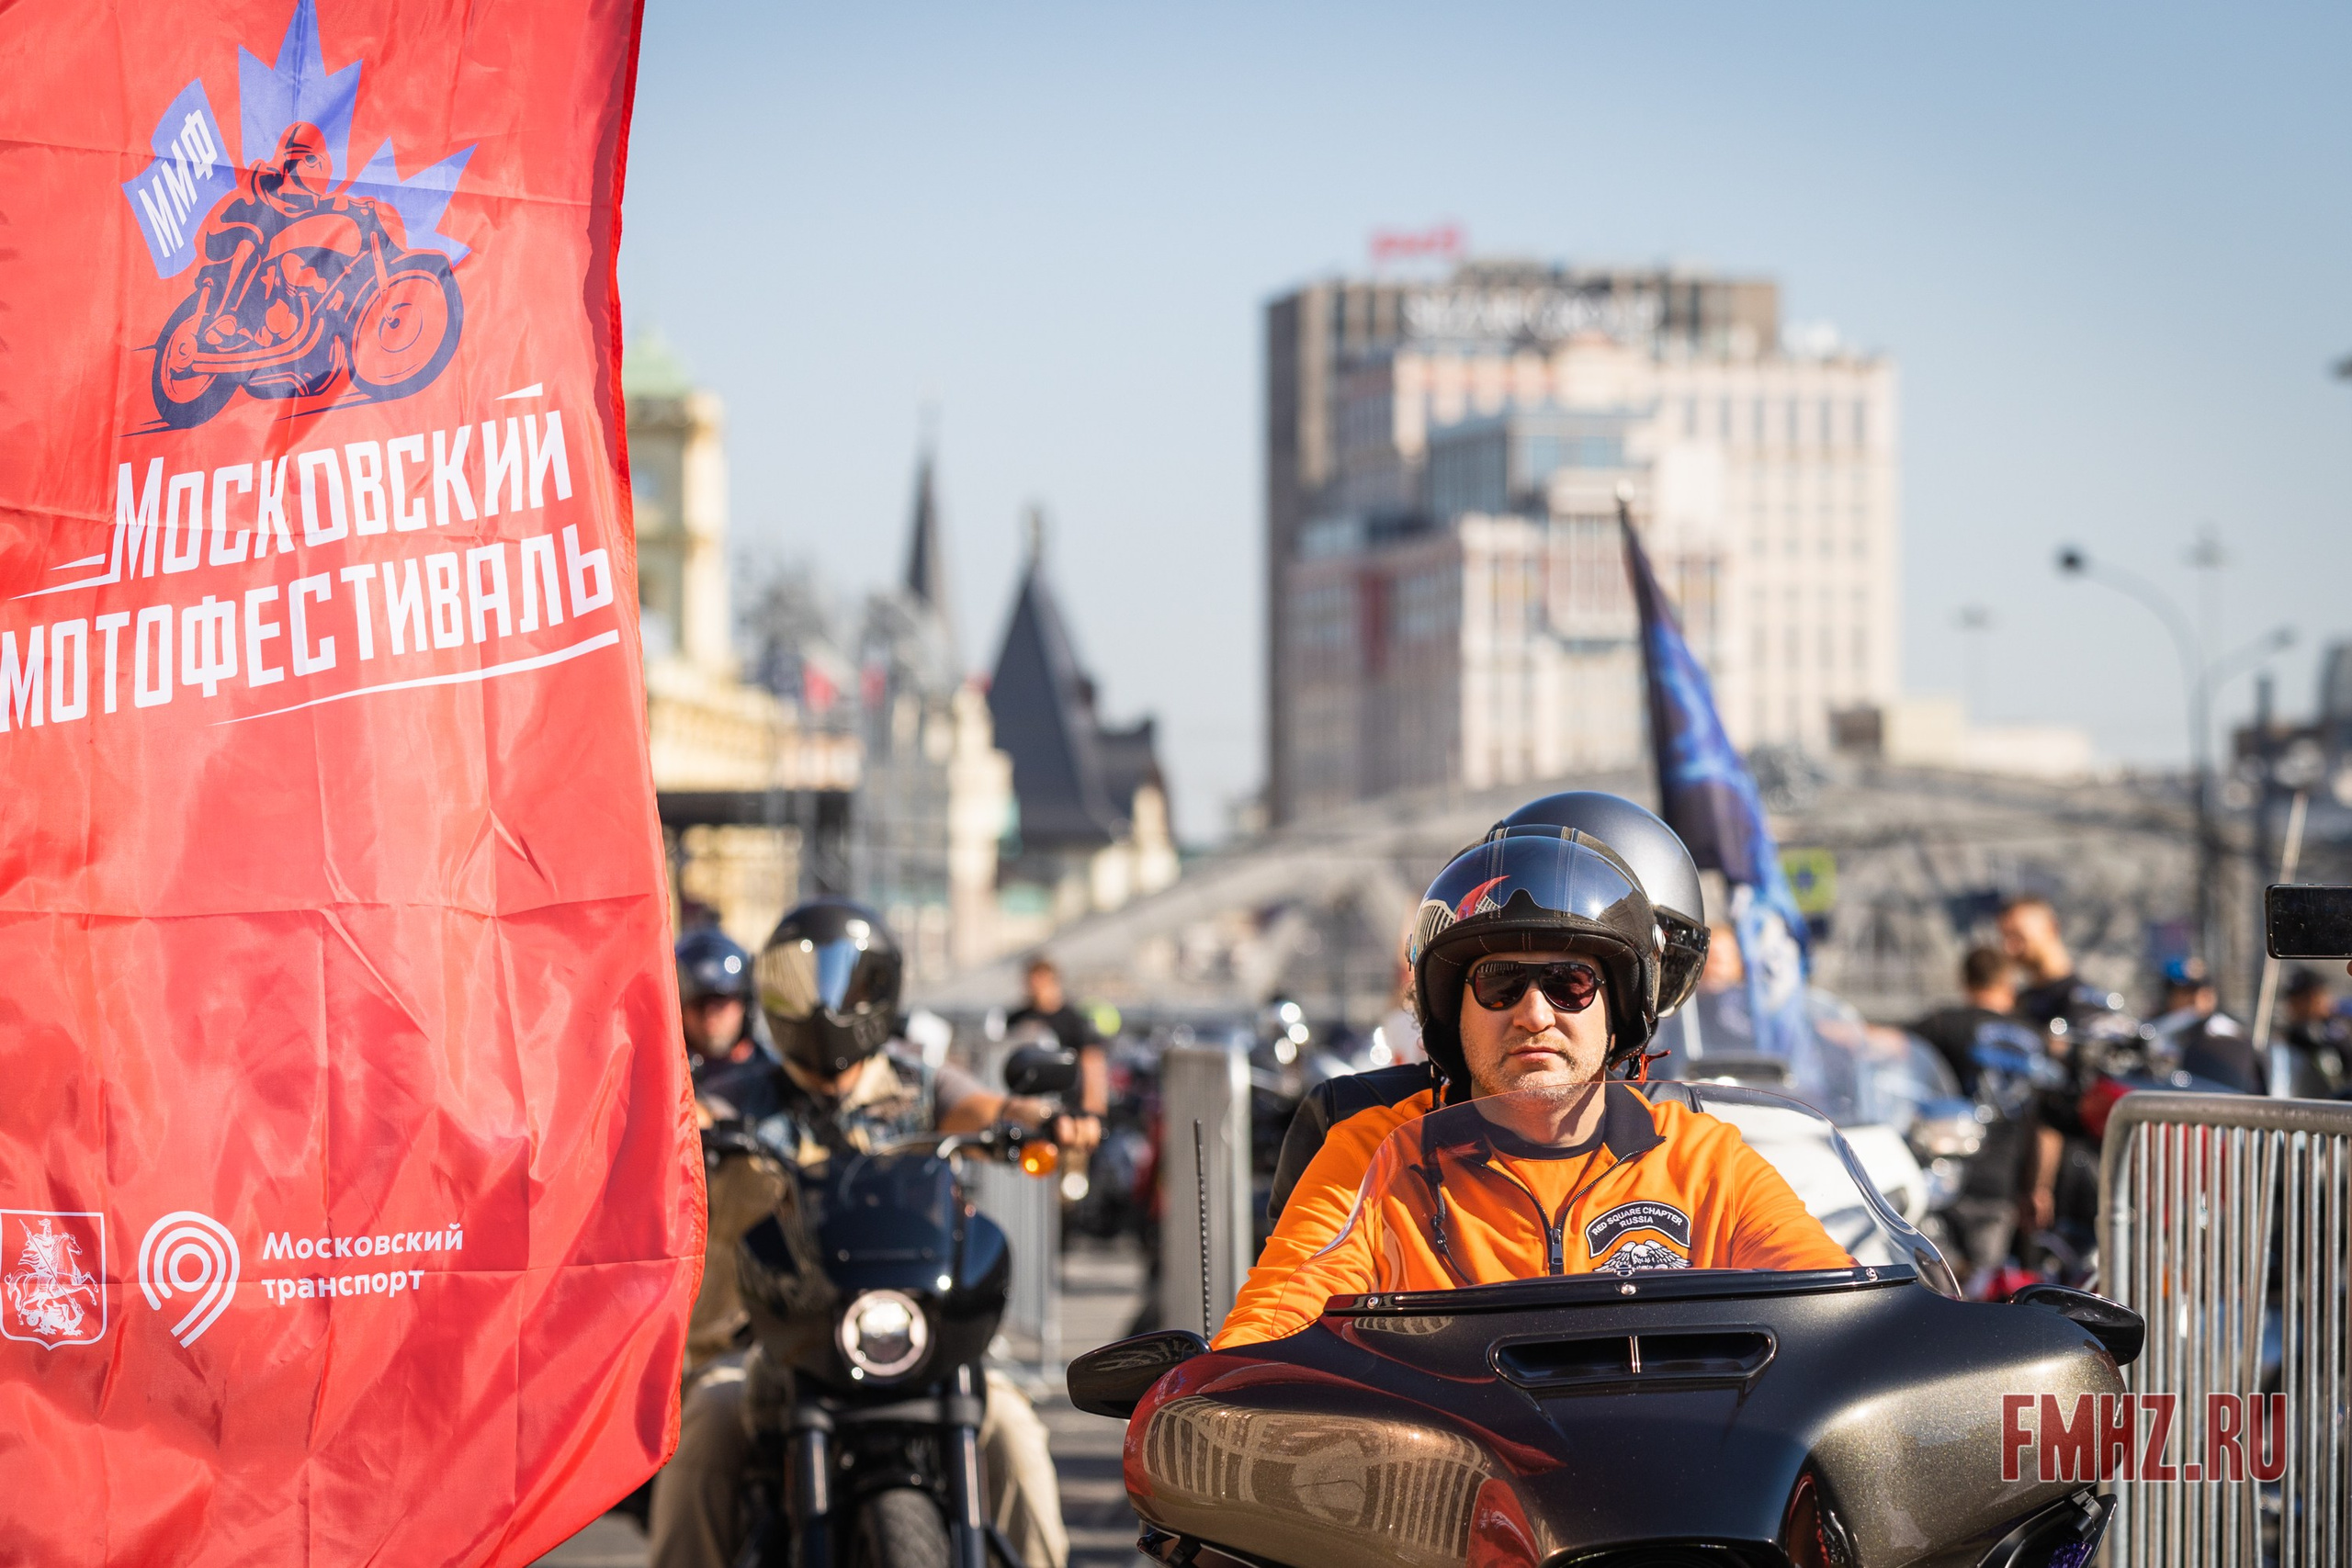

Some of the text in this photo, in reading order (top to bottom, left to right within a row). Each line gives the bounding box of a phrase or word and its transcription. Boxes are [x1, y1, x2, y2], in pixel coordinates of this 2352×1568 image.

[138, 109, 218, 258] ММФ
[0, 523, 615, 734] МОТОФЕСТИВАЛЬ
[1591, 1206, 1683, 1236] RED SQUARE CHAPTER
[1619, 1216, 1654, 1228] RUSSIA
[262, 1223, 464, 1260] Московский
[261, 1269, 425, 1305] транспорт
